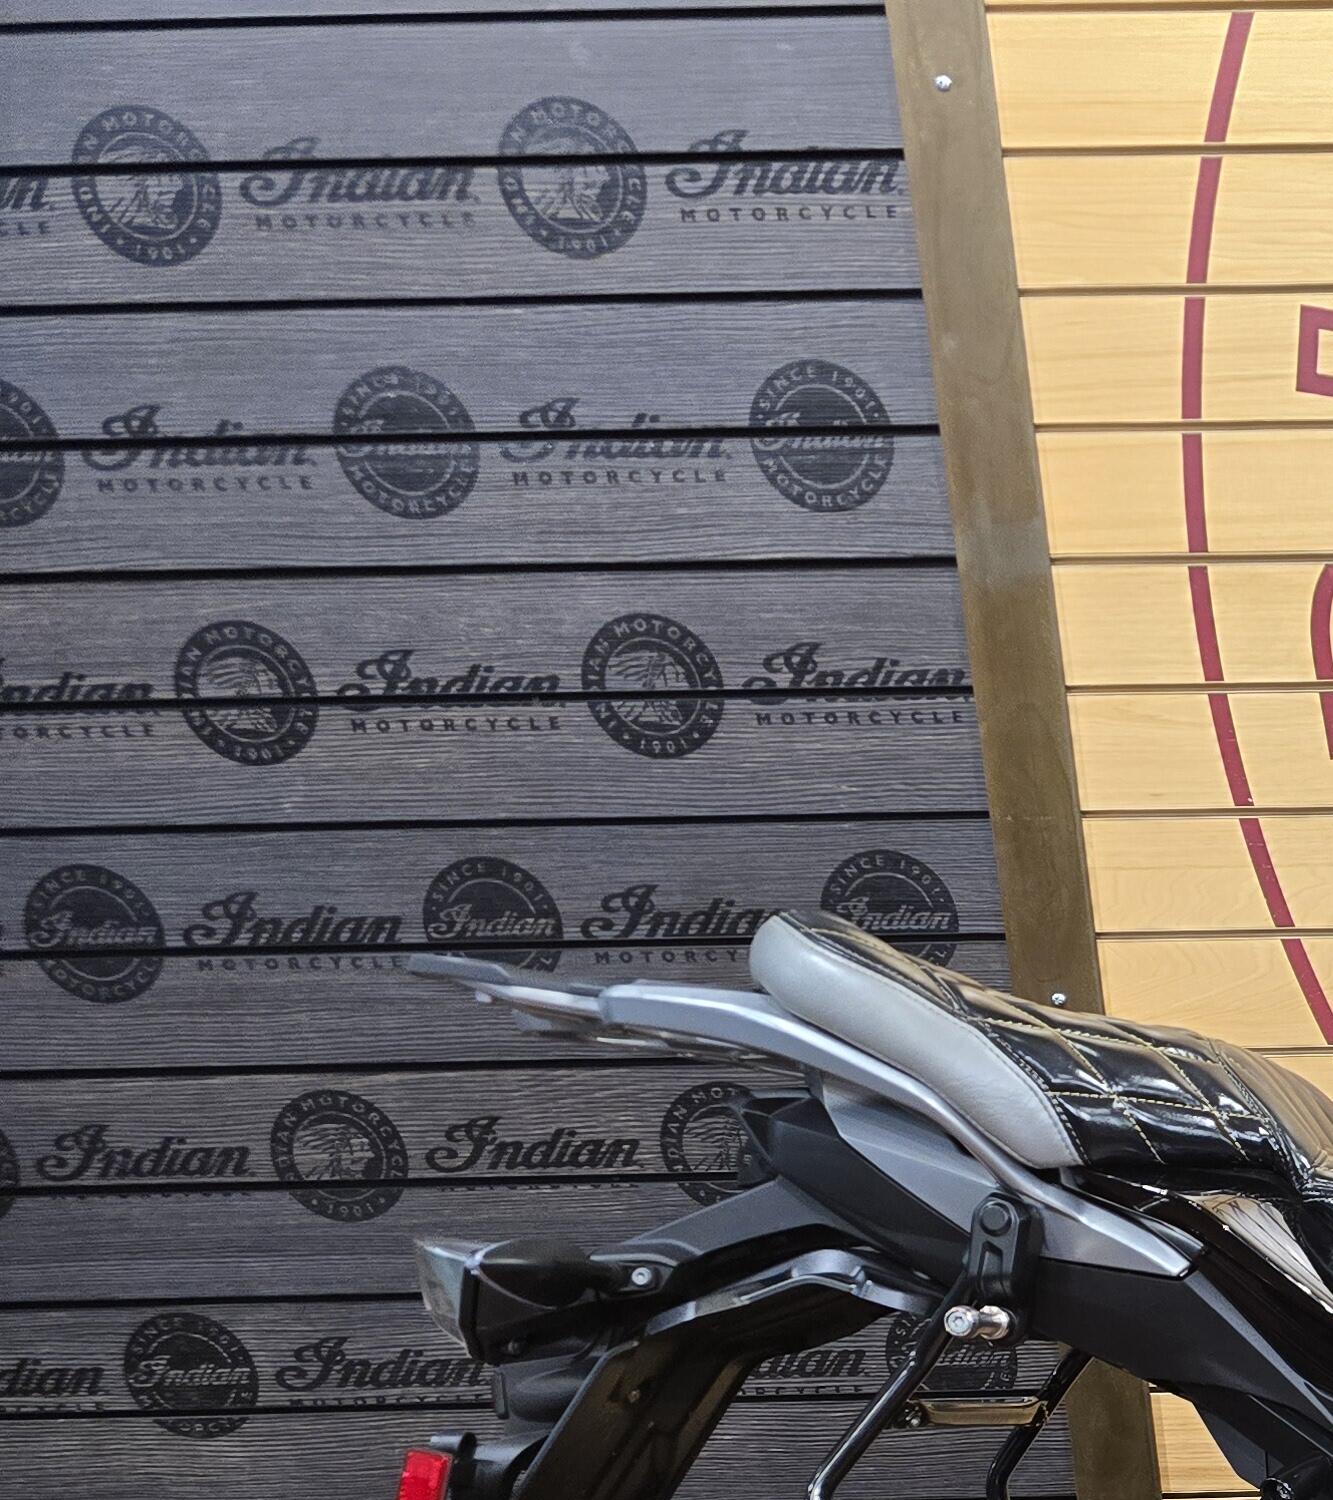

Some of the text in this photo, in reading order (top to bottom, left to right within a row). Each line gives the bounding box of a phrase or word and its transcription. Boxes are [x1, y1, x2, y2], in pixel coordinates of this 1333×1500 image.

[256, 211, 475, 230] MOTORCYCLE
[681, 205, 898, 223] MOTORCYCLE
[757, 364, 817, 411] SINCE
[98, 476, 314, 493] MOTORCYCLE
[512, 470, 727, 487] MOTORCYCLE
[335, 649, 560, 711] Indian
[742, 642, 967, 705] Indian
[351, 716, 561, 733] MOTORCYCLE
[756, 710, 965, 726] MOTORCYCLE
[183, 891, 401, 949] Indian
[427, 904, 555, 939] Indian
[197, 954, 402, 971] MOTORCYCLE
[35, 1125, 251, 1181] Indian
[425, 1117, 640, 1171] Indian
[326, 1202, 375, 1218] 1901
[128, 1354, 251, 1387] Indian
[275, 1337, 488, 1392] Indian
